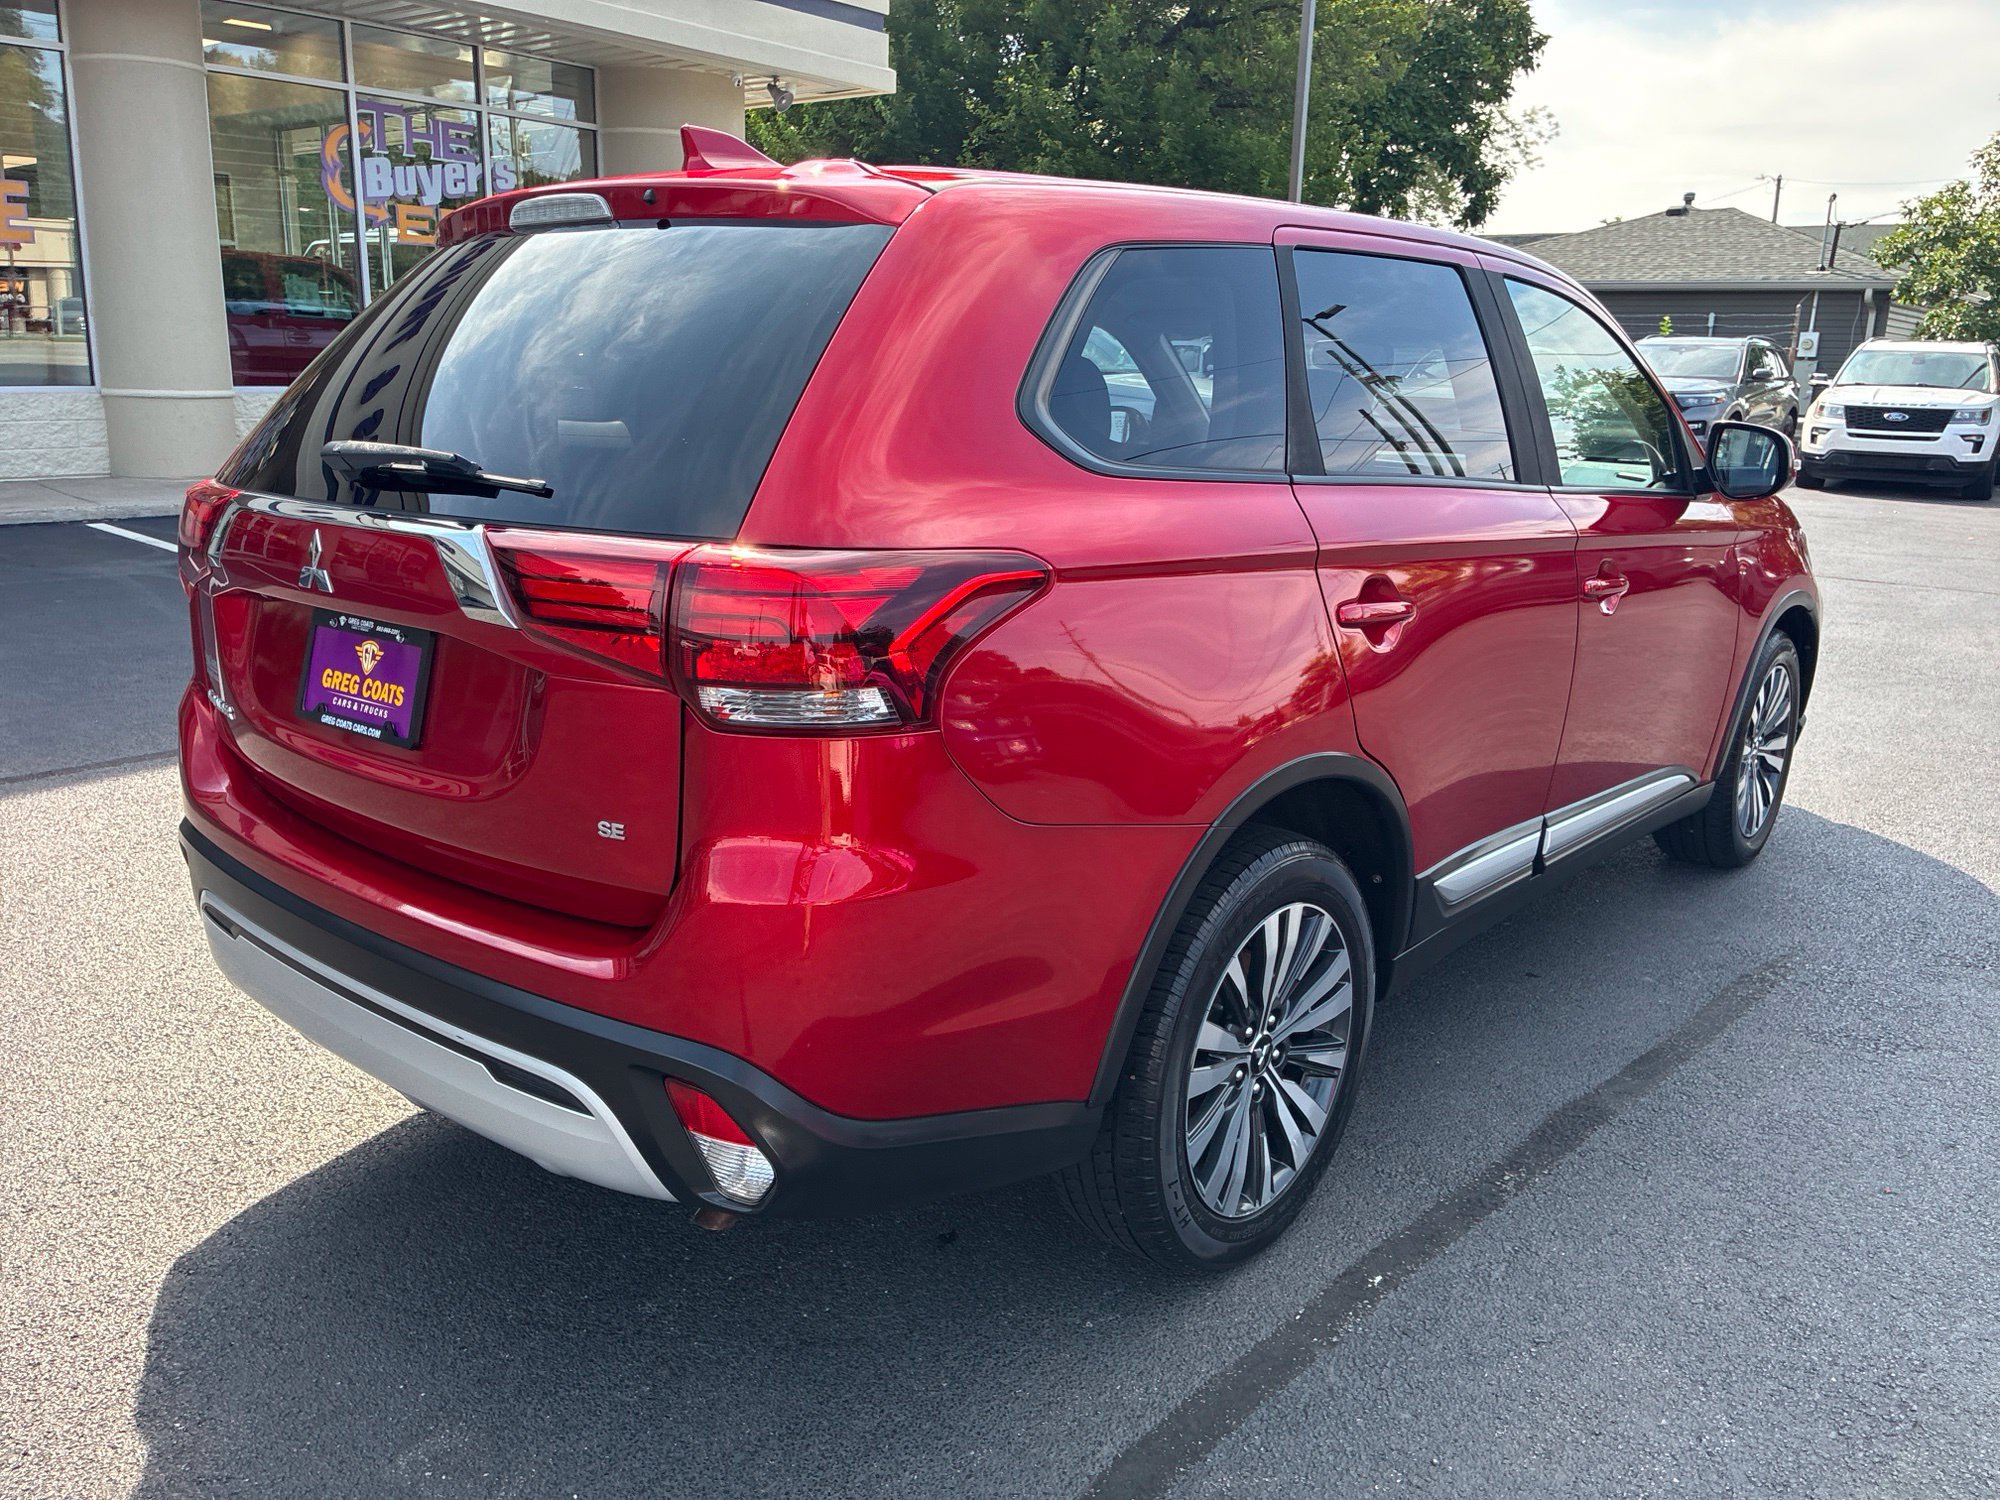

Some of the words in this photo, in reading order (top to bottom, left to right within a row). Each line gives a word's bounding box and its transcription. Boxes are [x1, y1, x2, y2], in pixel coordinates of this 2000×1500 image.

[356, 101, 476, 163] THE
[361, 157, 518, 206] Buyers
[322, 668, 360, 695] GREG
[362, 677, 405, 707] COATS
[332, 696, 352, 709] CARS
[352, 702, 358, 711] &
[359, 703, 389, 719] TRUCKS
[321, 714, 336, 725] GREG
[335, 718, 353, 731] COATS
[352, 723, 382, 739] CARS.COM
[597, 820, 626, 841] SE
